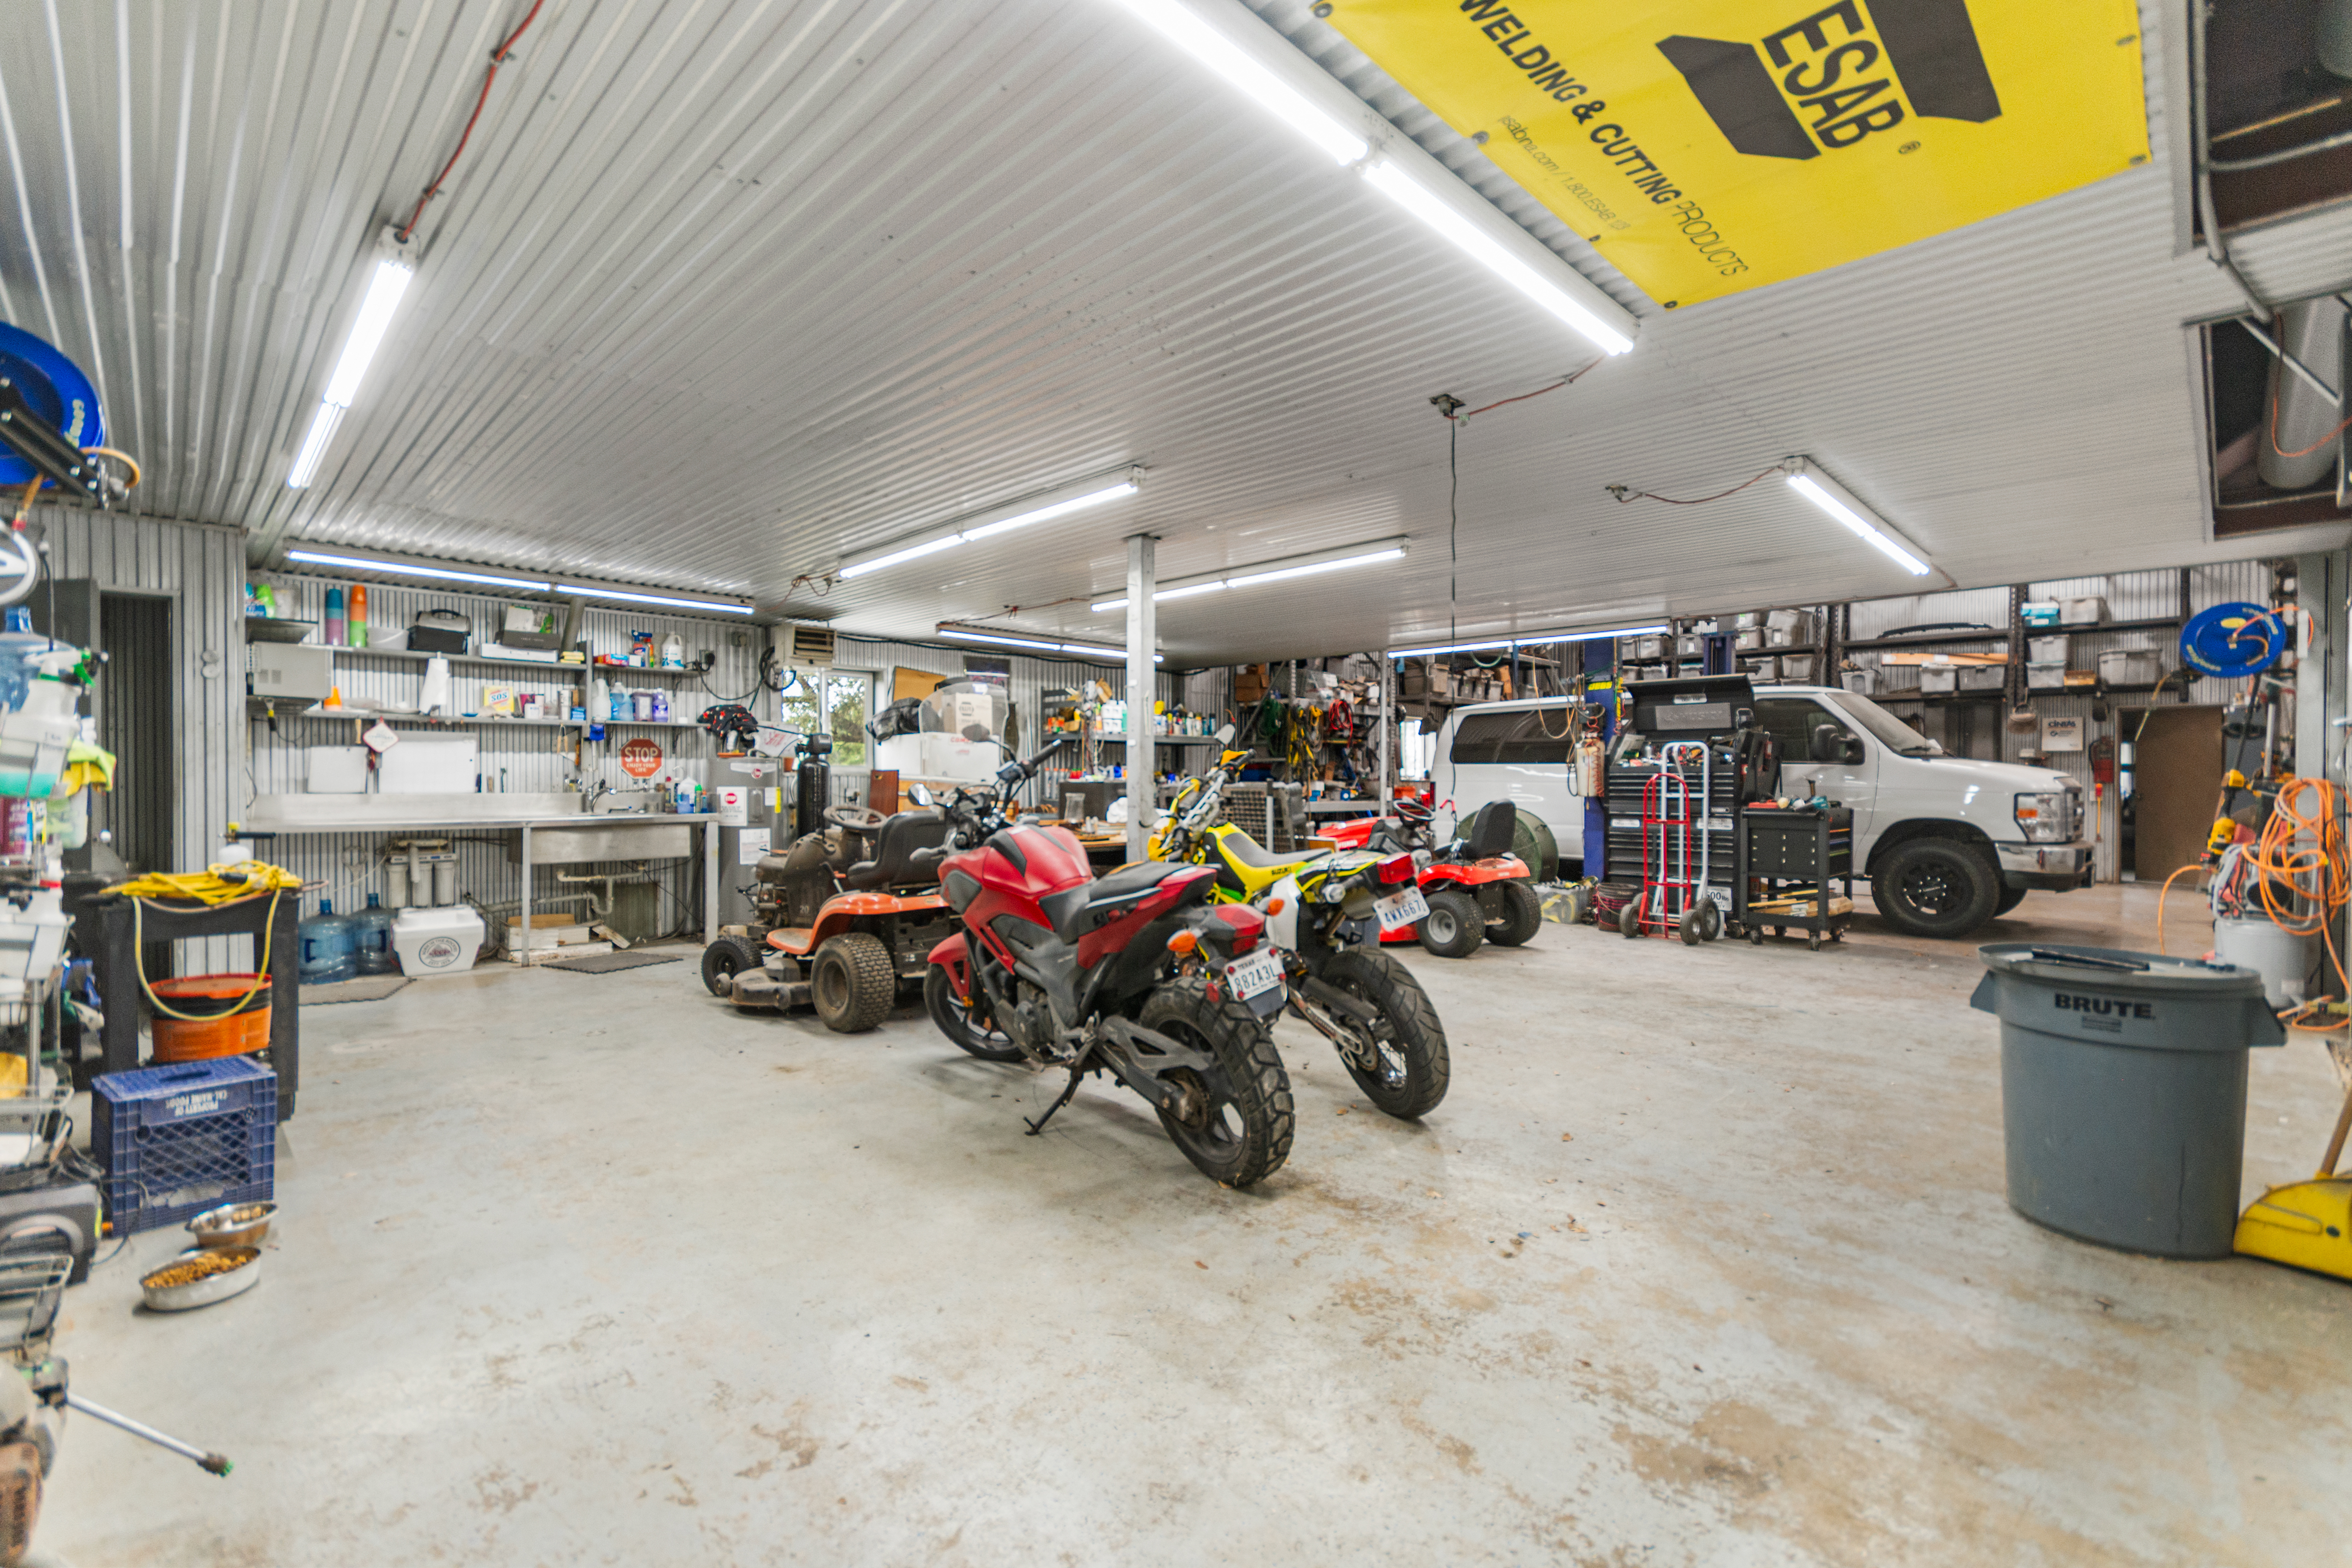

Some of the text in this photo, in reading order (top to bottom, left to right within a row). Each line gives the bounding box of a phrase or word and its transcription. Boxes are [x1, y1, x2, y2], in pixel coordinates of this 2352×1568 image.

[1761, 0, 1905, 149] ESAB
[1459, 0, 1749, 276] WELDING & CUTTING PRODUCTS
[490, 692, 507, 702] SOS
[624, 746, 659, 762] STOP
[1271, 867, 1292, 876] SUZUKI
[1384, 900, 1421, 924] 4WX667
[1234, 963, 1279, 992] 882A3L
[2055, 993, 2152, 1019] BRUTE
